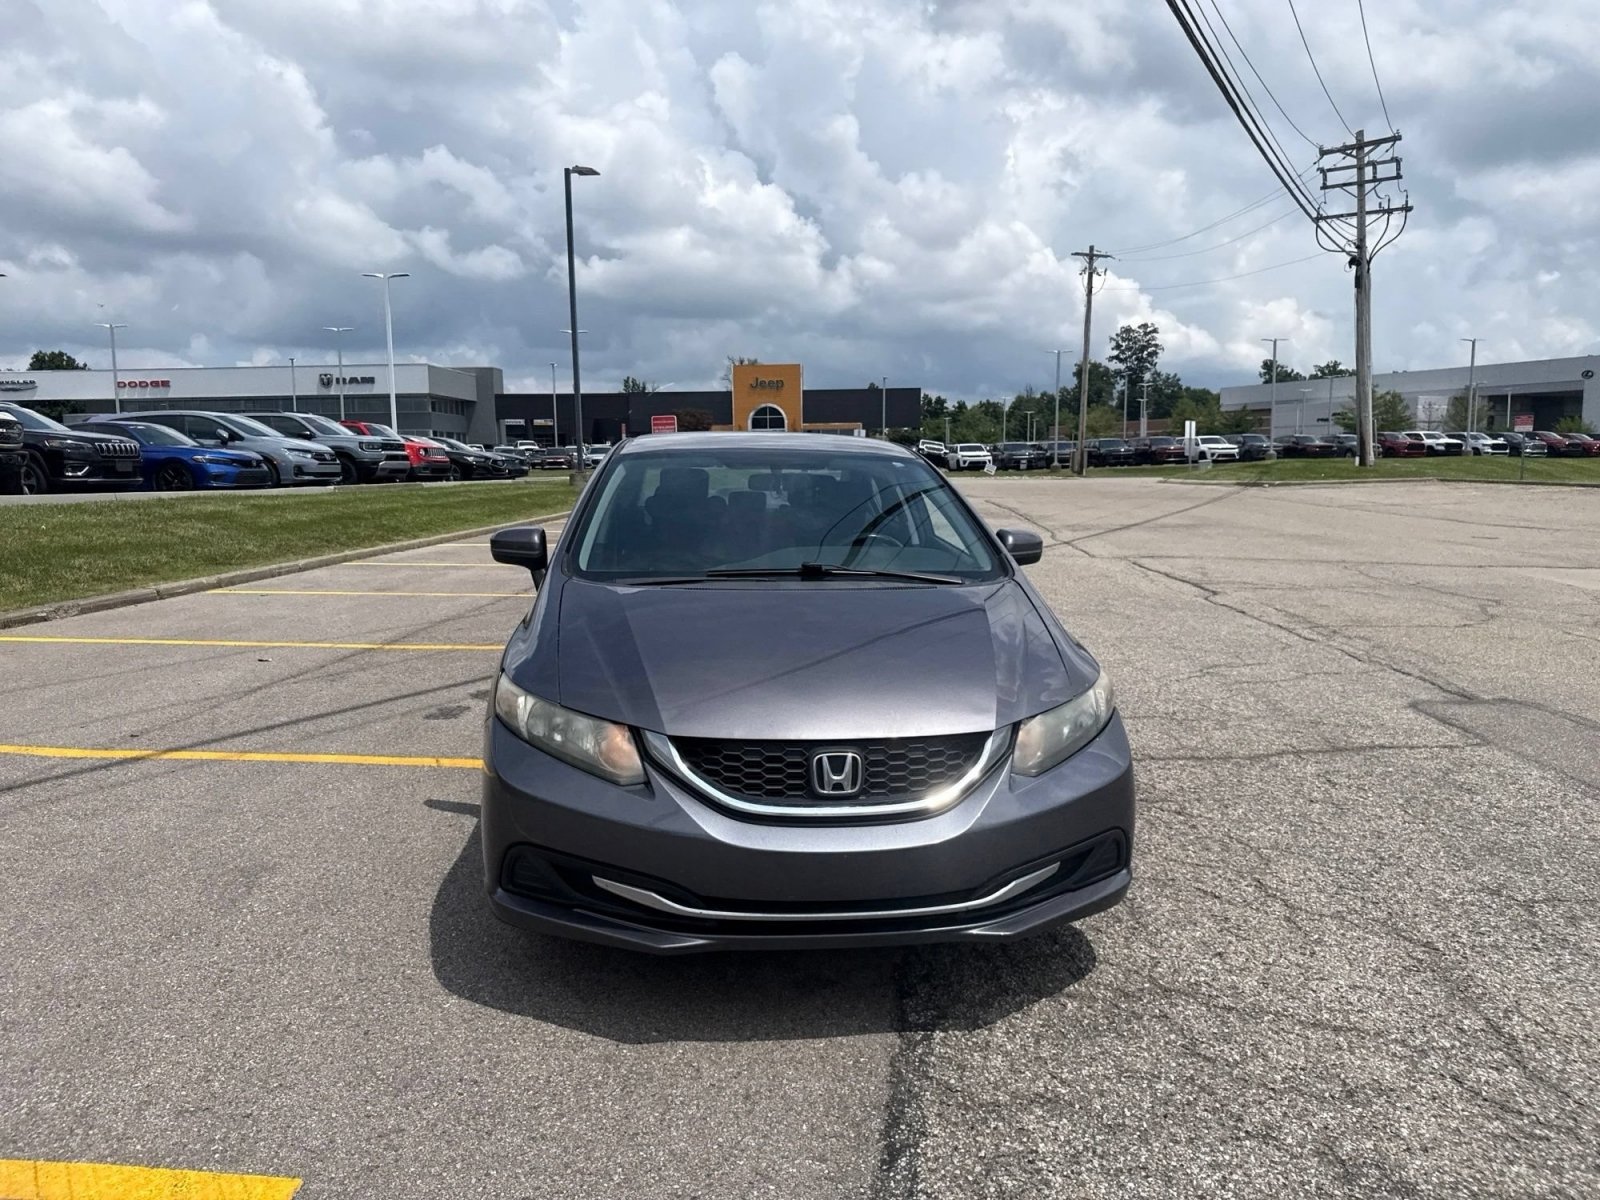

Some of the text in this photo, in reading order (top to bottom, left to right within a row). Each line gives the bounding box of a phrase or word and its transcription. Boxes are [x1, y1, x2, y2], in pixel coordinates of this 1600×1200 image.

[117, 380, 170, 388] DODGE
[335, 376, 375, 385] RAM
[750, 377, 784, 391] Jeep
